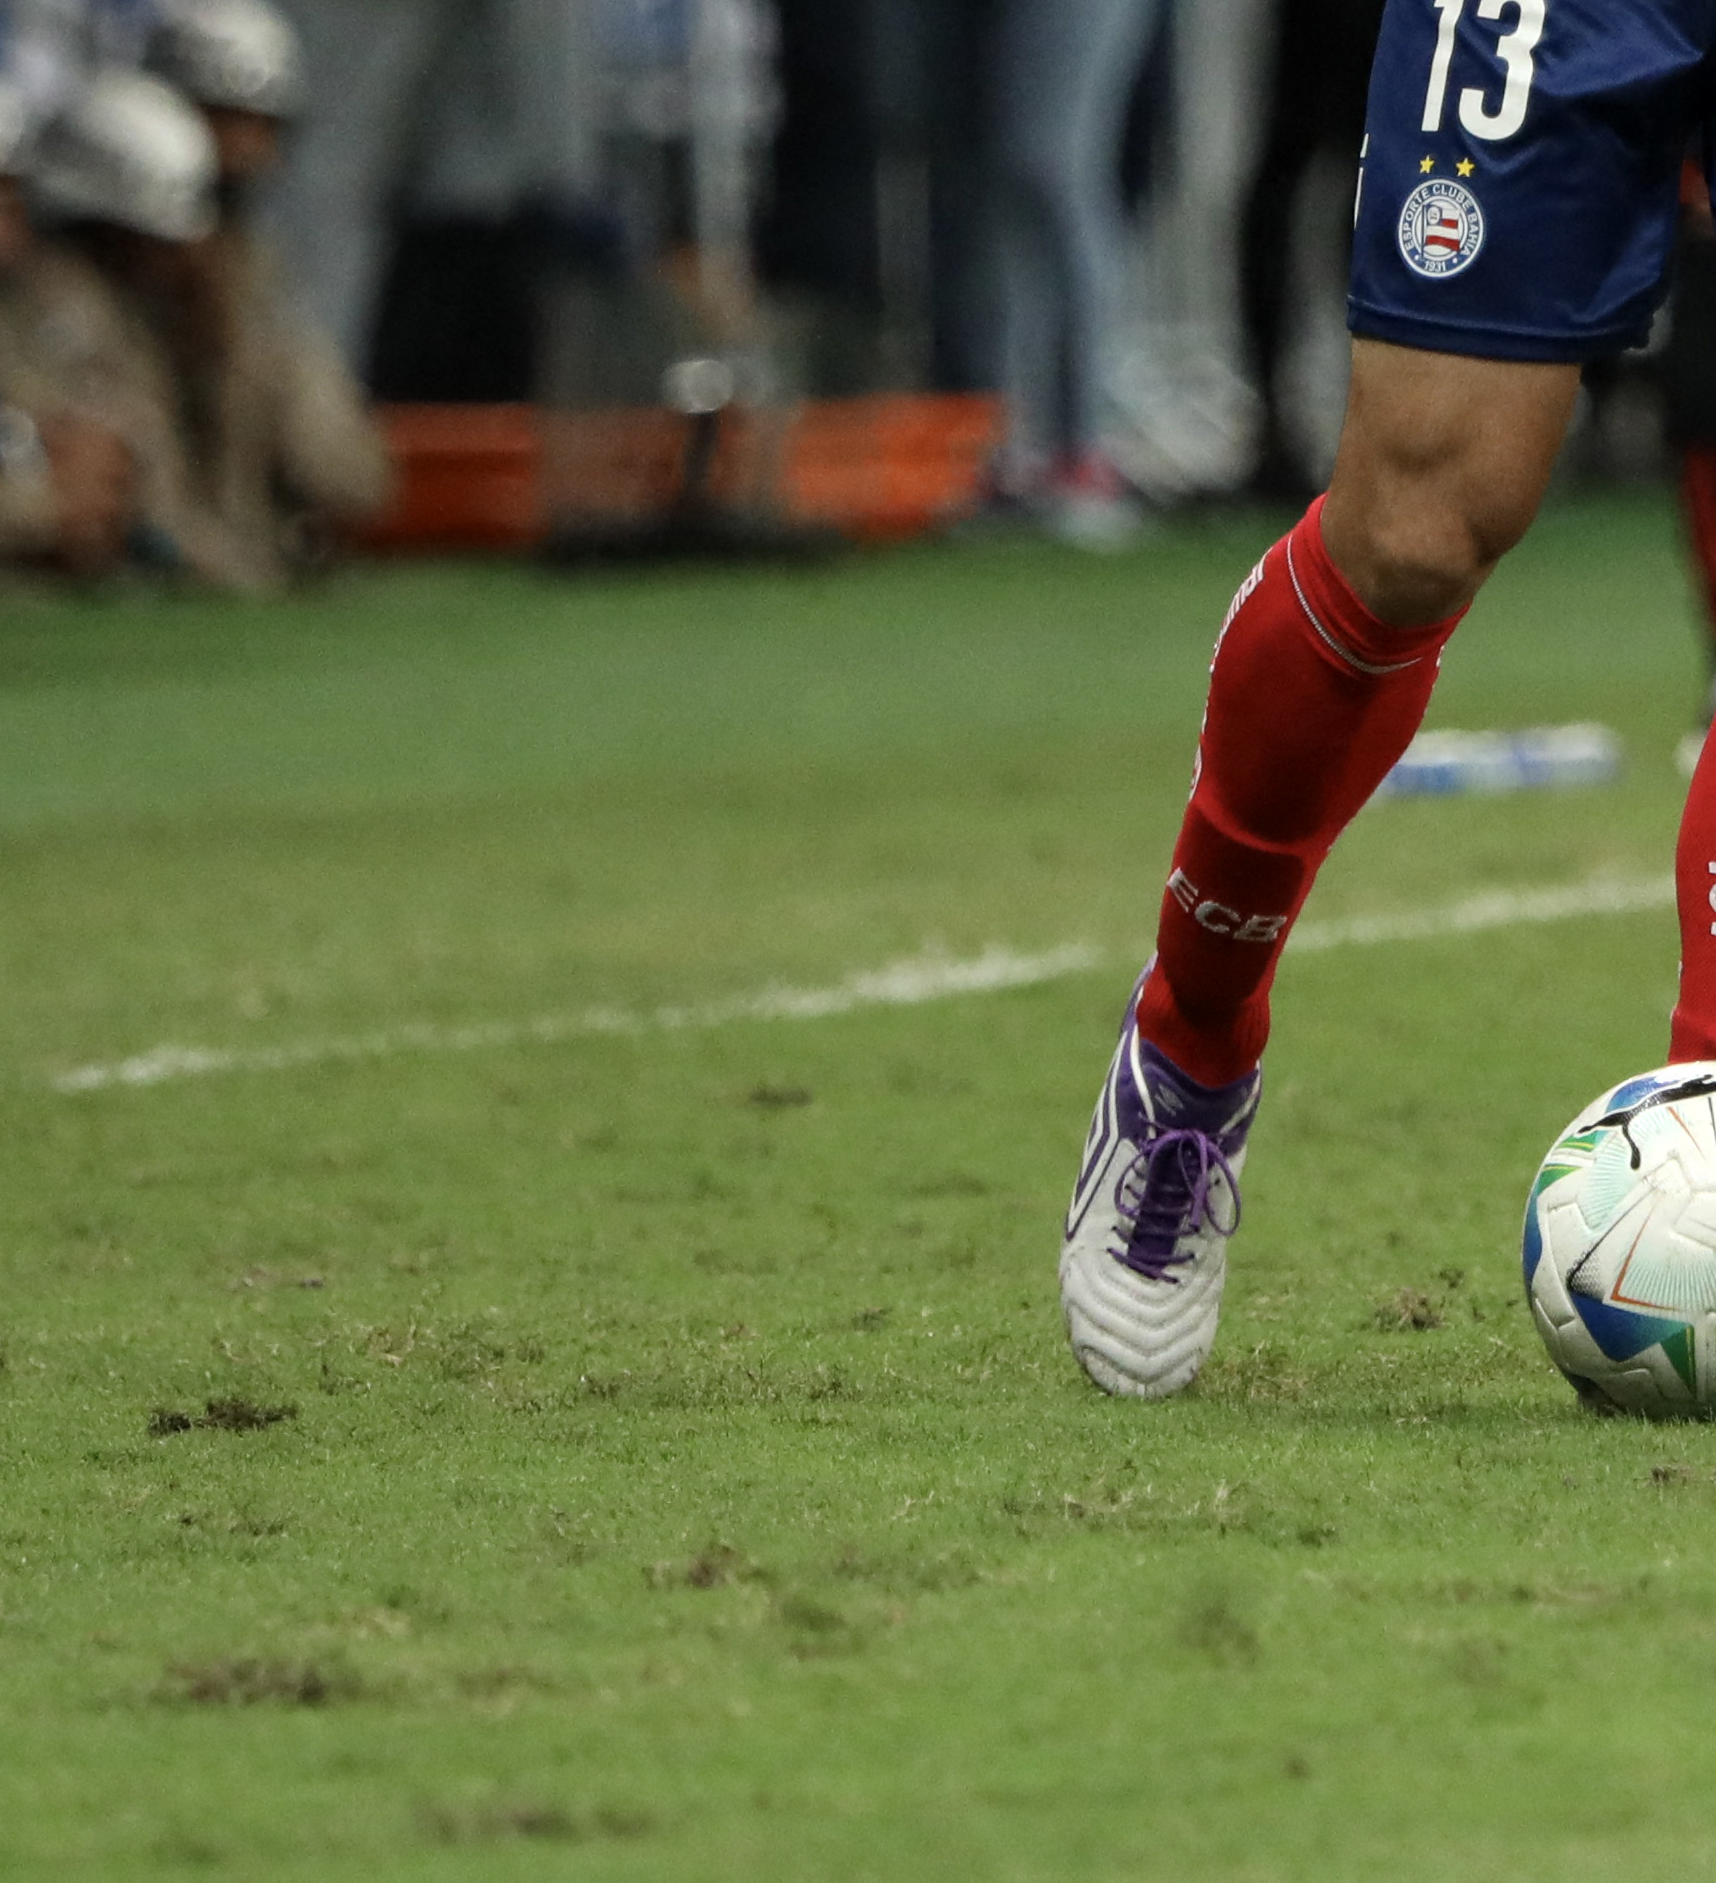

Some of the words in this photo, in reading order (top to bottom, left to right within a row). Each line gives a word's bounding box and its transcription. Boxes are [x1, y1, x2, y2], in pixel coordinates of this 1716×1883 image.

[1403, 187, 1430, 251] ESPORTE
[1432, 184, 1471, 211] CLUBE
[1461, 213, 1479, 256] BAHIA
[1424, 260, 1447, 273] 1931
[1166, 867, 1287, 943] ECB
